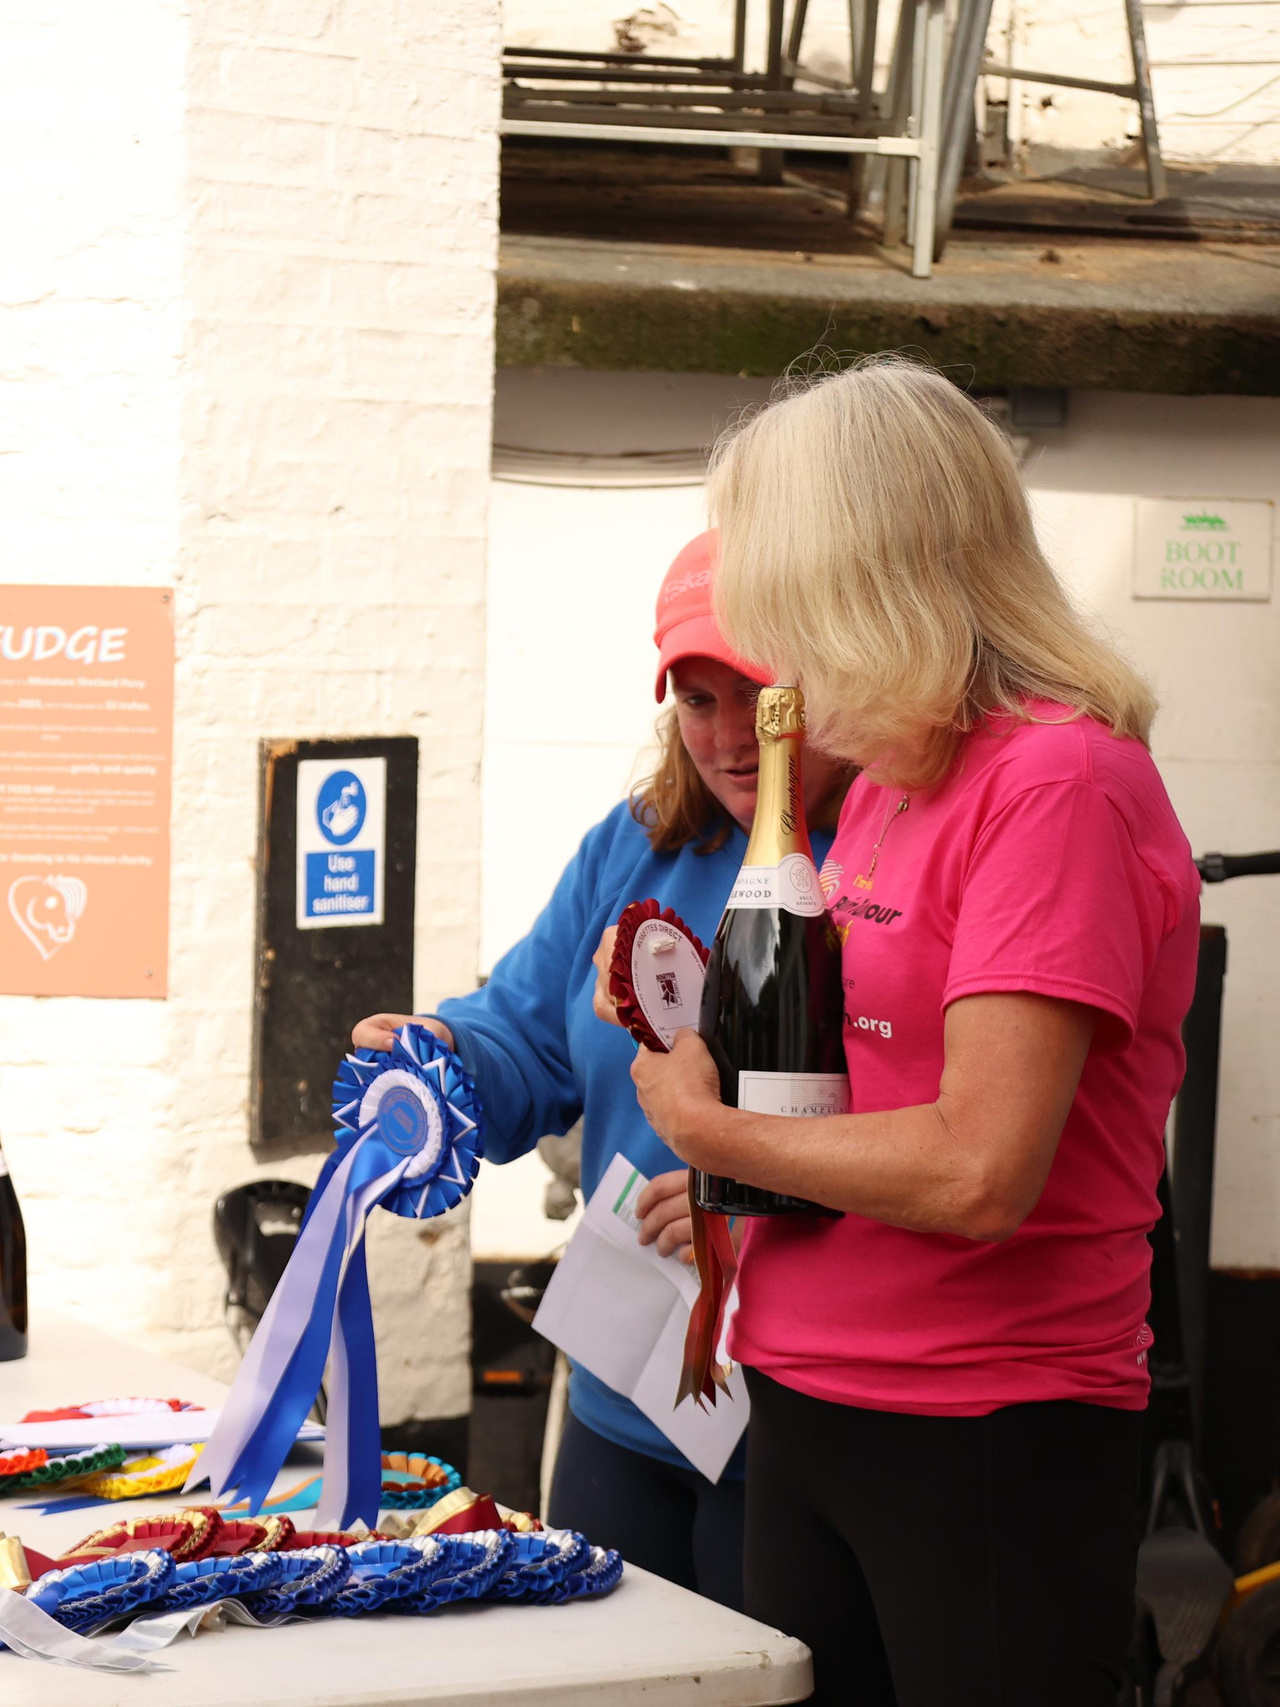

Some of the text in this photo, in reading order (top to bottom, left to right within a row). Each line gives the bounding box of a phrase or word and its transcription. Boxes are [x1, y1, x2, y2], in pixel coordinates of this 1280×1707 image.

[1165, 540, 1242, 564] BOOT
[1160, 567, 1245, 590] ROOM
[780, 754, 801, 836] Champagne
[328, 854, 355, 872] Use
[324, 873, 359, 892] hand
[313, 894, 369, 914] sanitiser
[659, 924, 683, 943] DIRECT
